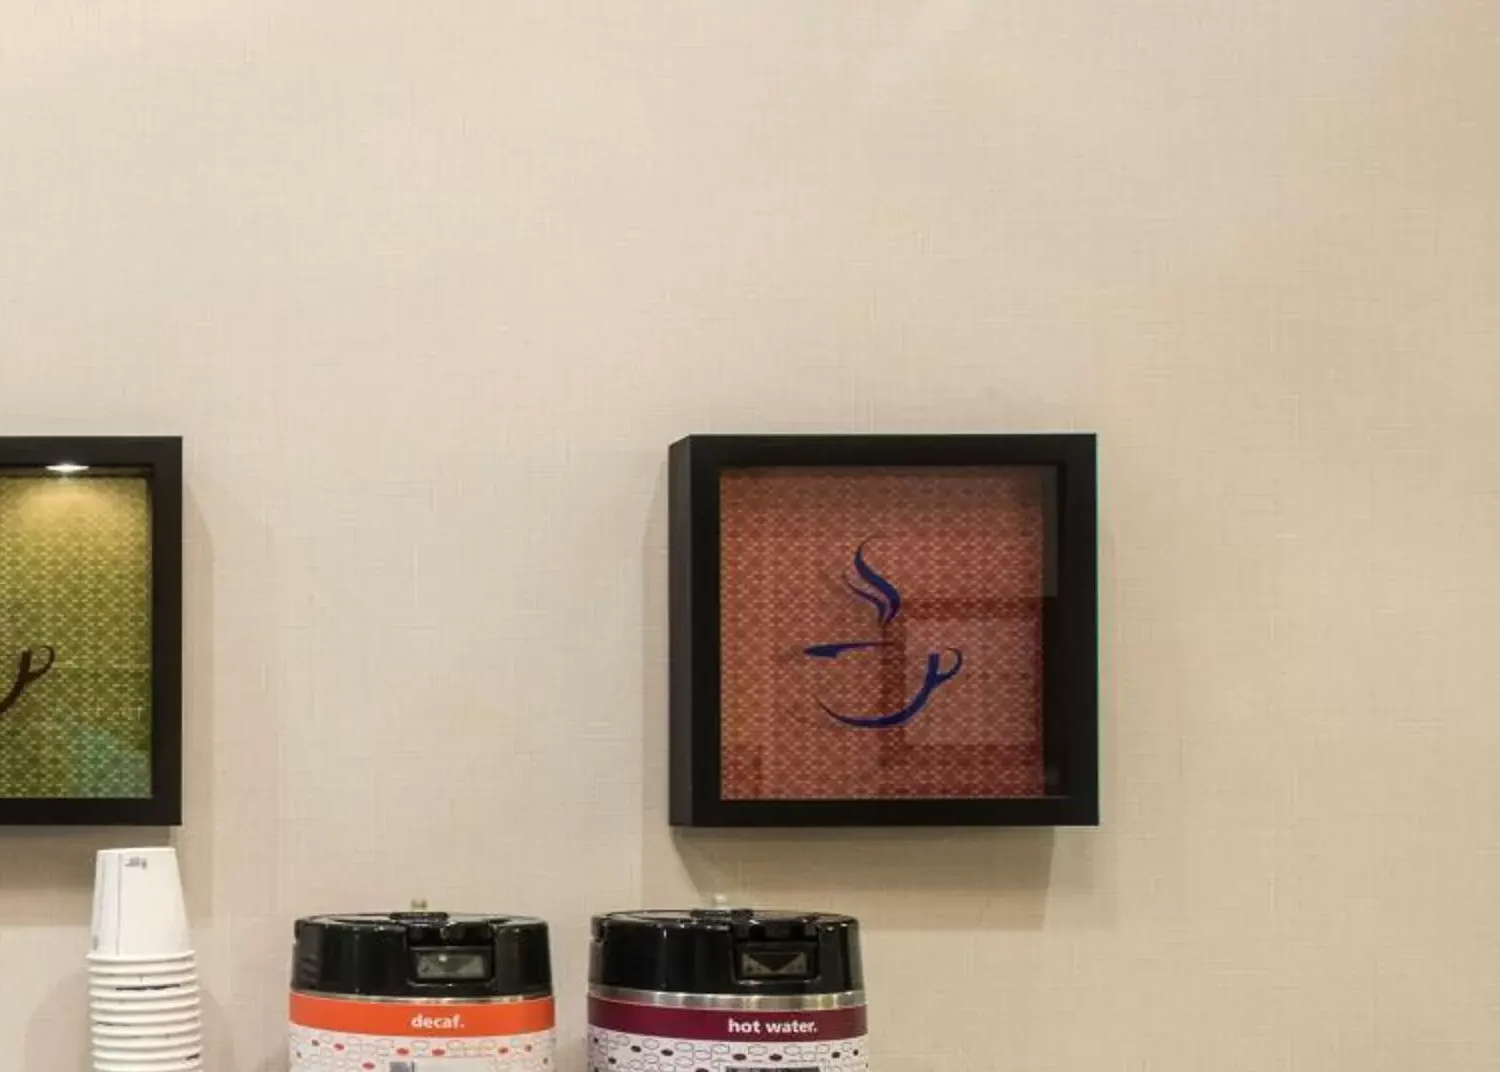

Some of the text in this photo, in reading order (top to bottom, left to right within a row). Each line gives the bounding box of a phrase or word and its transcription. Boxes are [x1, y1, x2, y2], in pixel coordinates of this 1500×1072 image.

[411, 1014, 466, 1029] decaf.
[728, 1018, 817, 1033] hot water.
